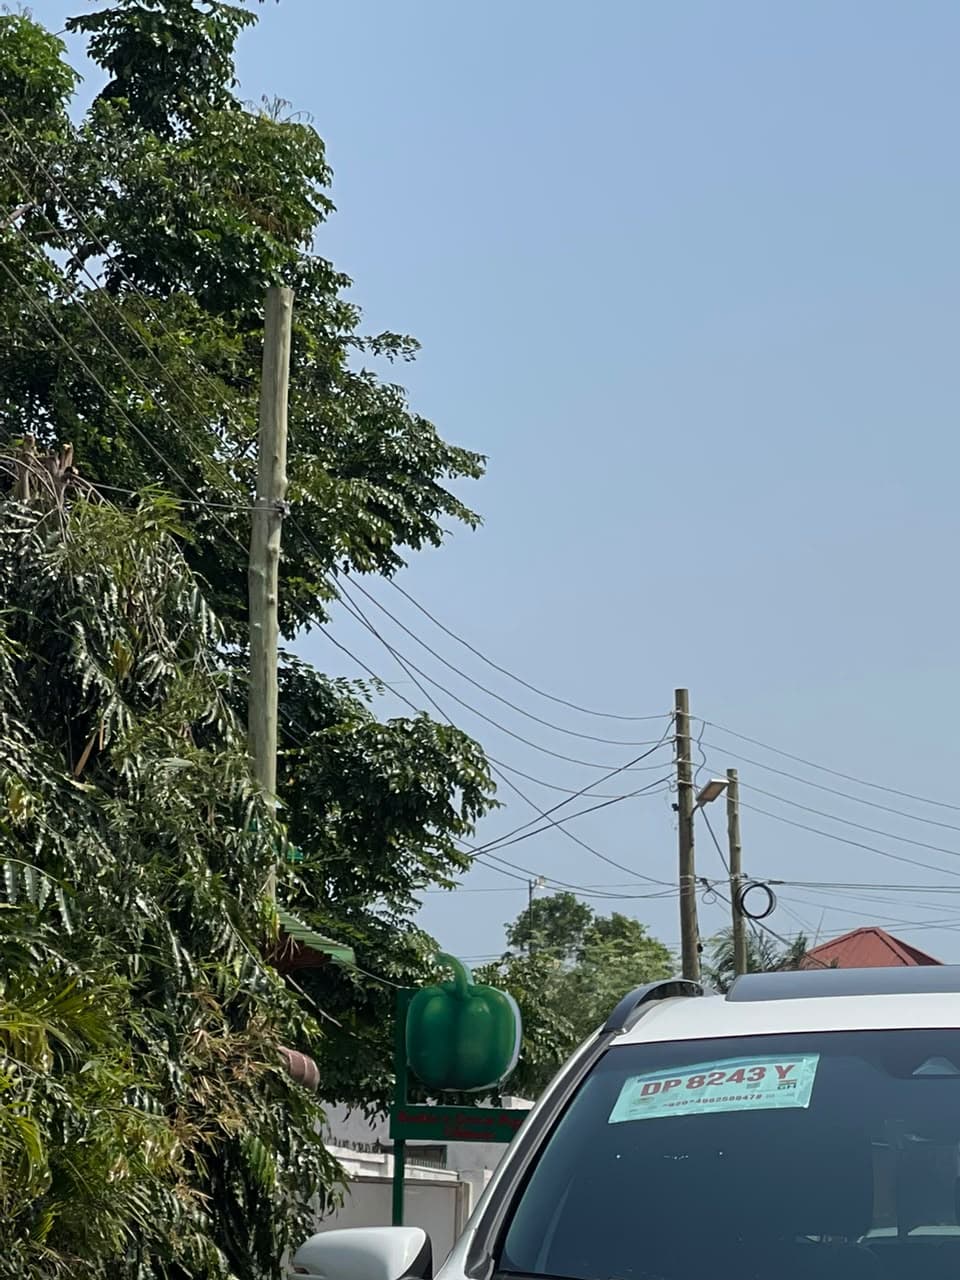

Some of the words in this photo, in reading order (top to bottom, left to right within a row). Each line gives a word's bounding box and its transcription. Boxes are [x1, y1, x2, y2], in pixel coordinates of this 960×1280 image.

[640, 1079, 682, 1097] DP
[685, 1066, 767, 1089] 8243
[774, 1064, 796, 1079] Y
